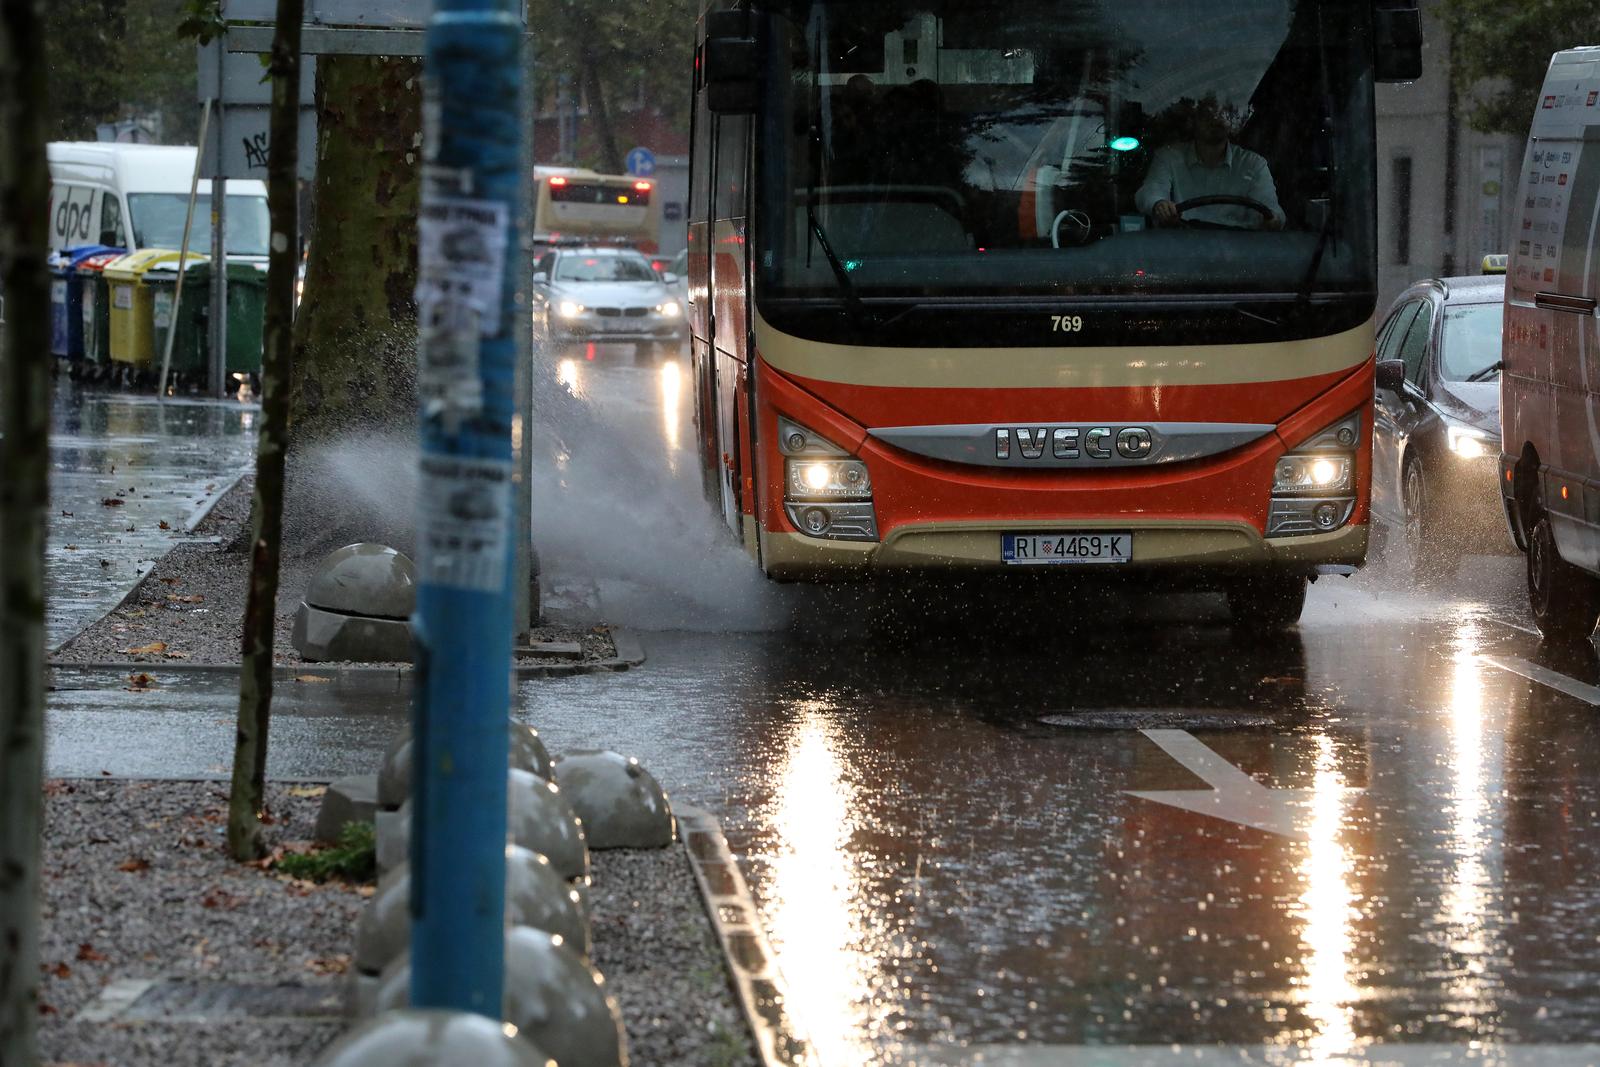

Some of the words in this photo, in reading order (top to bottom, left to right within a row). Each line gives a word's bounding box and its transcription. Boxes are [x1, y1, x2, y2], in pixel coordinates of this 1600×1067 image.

[56, 186, 95, 247] dpd
[1051, 315, 1082, 332] 769
[995, 427, 1152, 460] IVECO
[1016, 537, 1037, 558] RI
[1054, 536, 1122, 557] 4469-K
